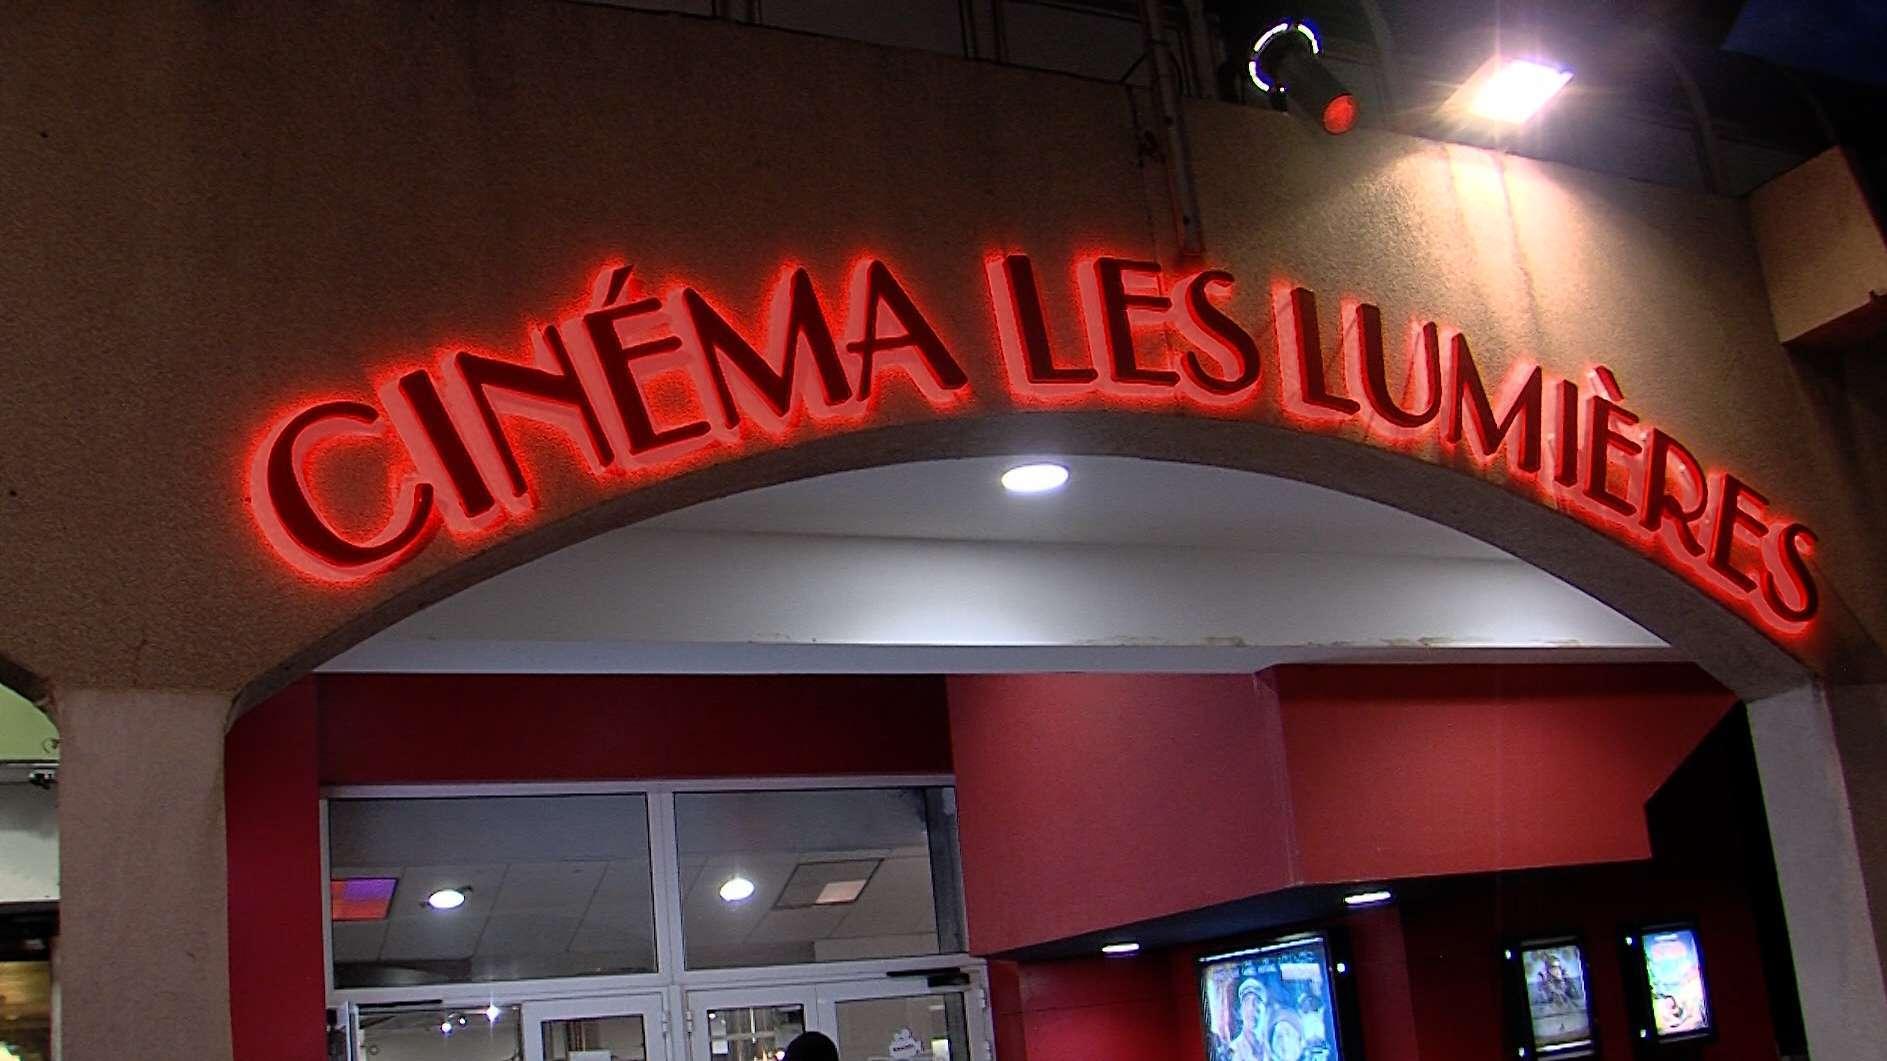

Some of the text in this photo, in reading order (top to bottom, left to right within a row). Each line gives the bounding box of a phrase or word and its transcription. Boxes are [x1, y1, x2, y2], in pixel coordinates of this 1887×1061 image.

[266, 254, 1819, 623] CINÉMA LES LUMIÈRES
